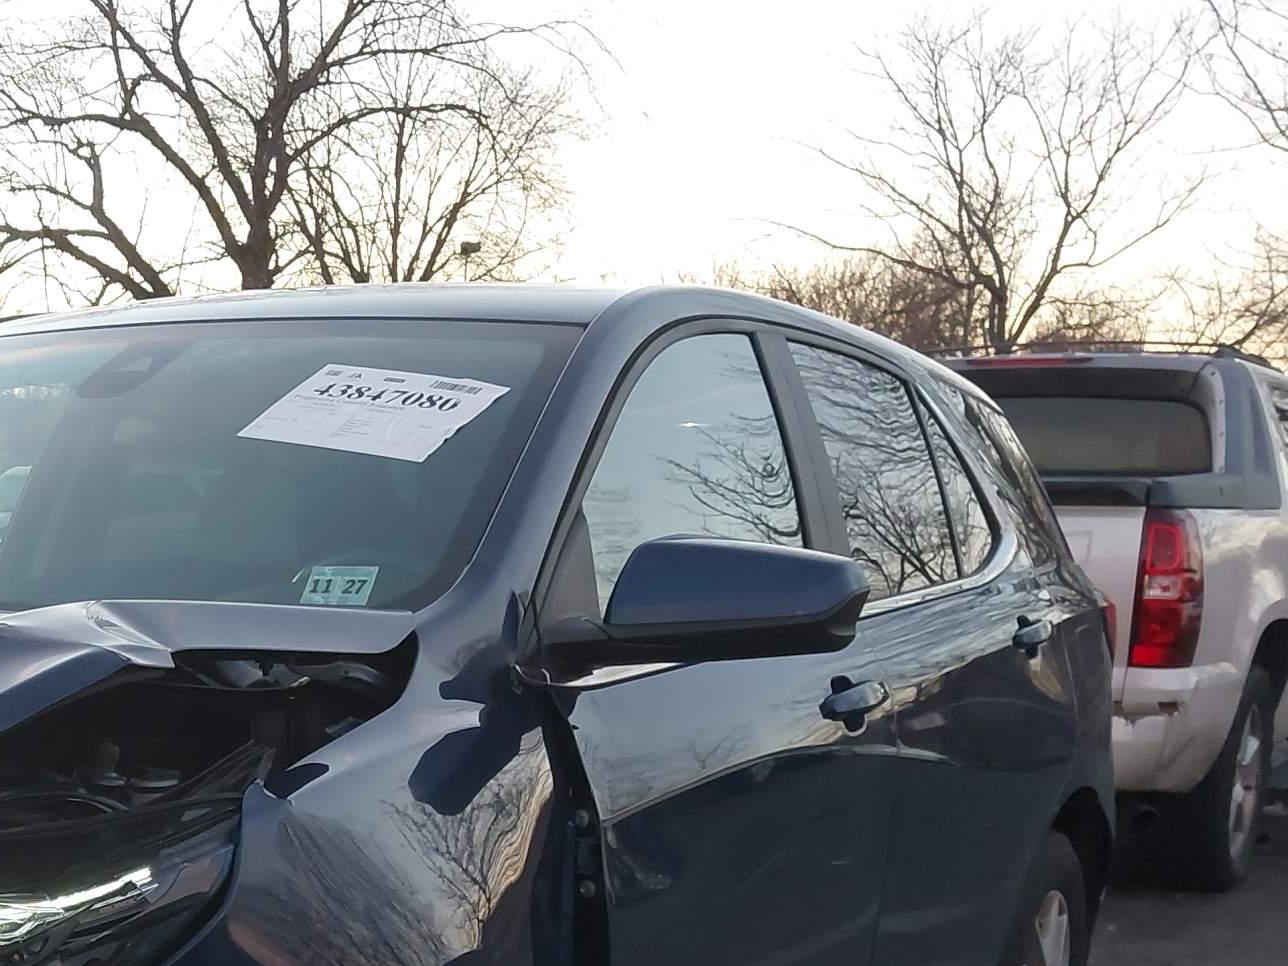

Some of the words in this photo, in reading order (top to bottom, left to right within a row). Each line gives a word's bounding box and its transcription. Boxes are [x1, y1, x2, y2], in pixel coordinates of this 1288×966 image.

[313, 382, 462, 412] 43847080
[308, 578, 333, 594] 11
[341, 579, 369, 595] 27
